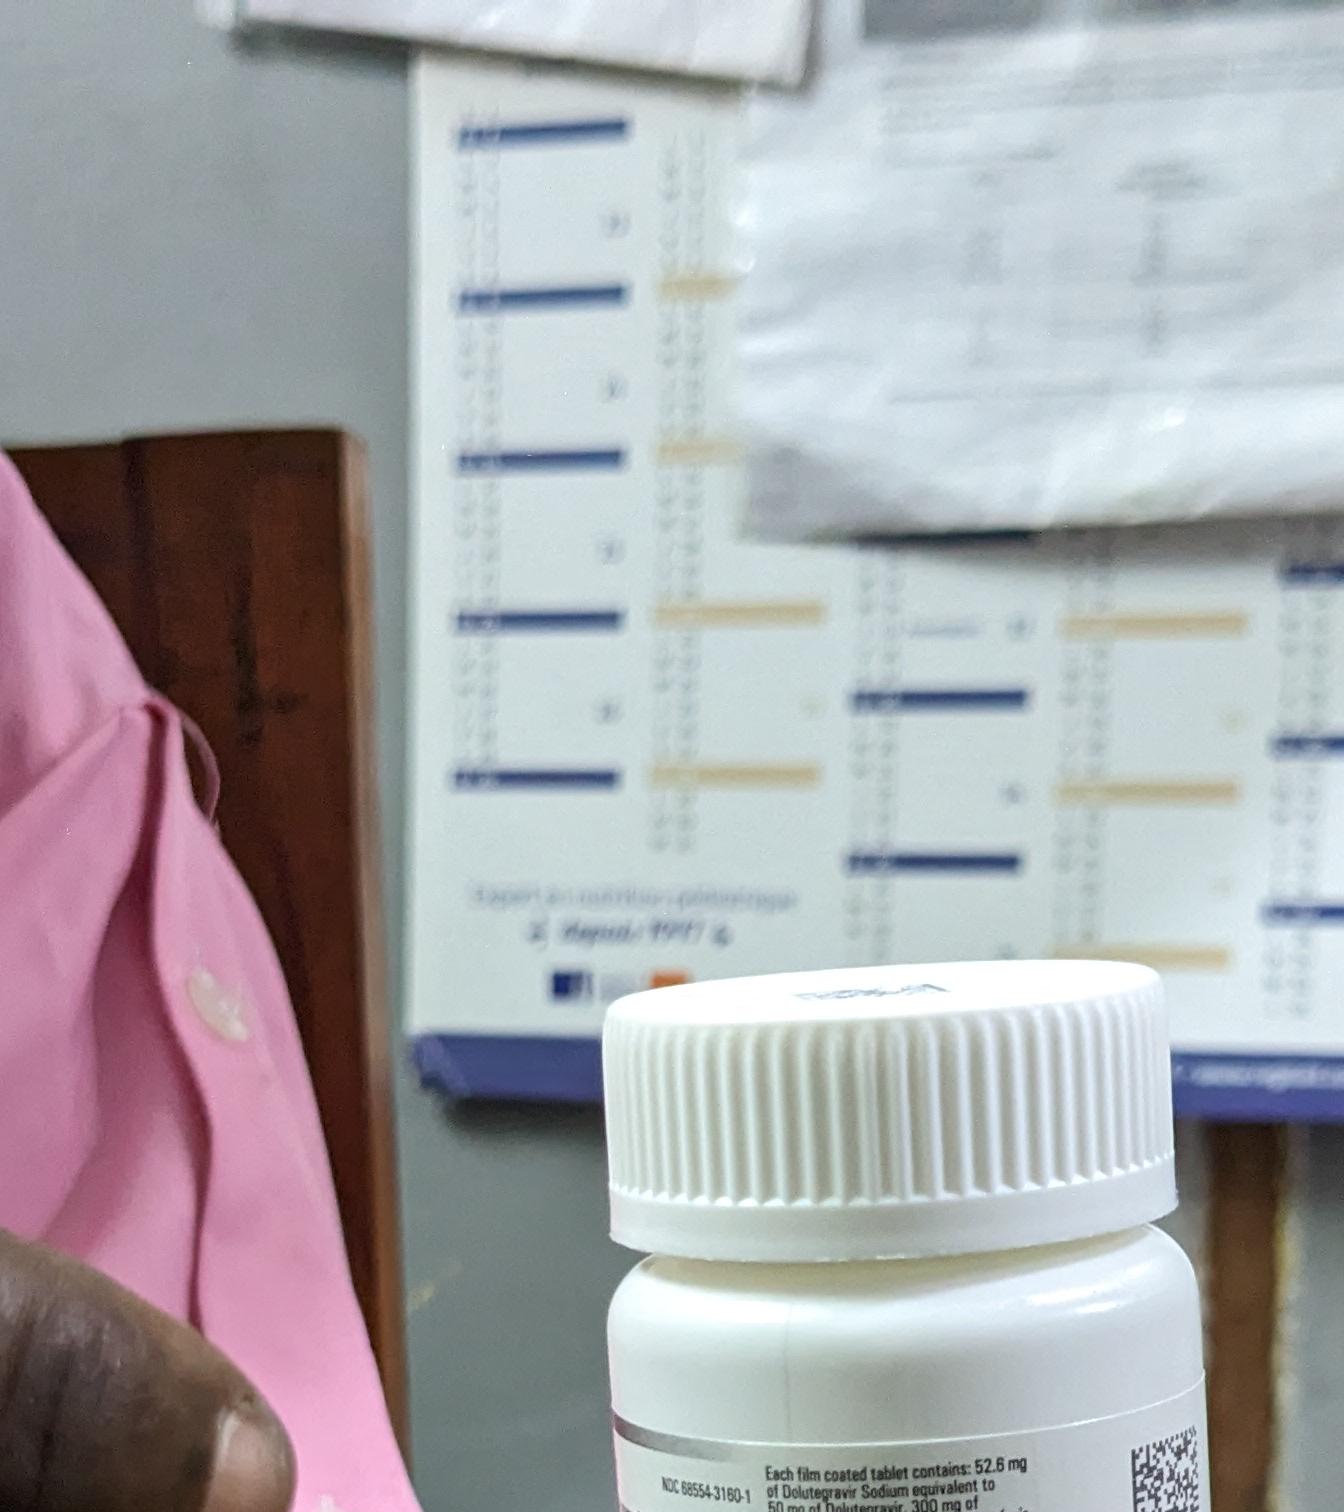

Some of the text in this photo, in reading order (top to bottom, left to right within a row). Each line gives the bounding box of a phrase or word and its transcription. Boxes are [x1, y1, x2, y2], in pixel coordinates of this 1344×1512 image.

[765, 1457, 1027, 1481] Each film coated tablet contains: 52.6 mg
[662, 1476, 680, 1494] NDC
[768, 1479, 995, 1501] of Dolutegravir Sodium equivalent to
[965, 1495, 978, 1510] of
